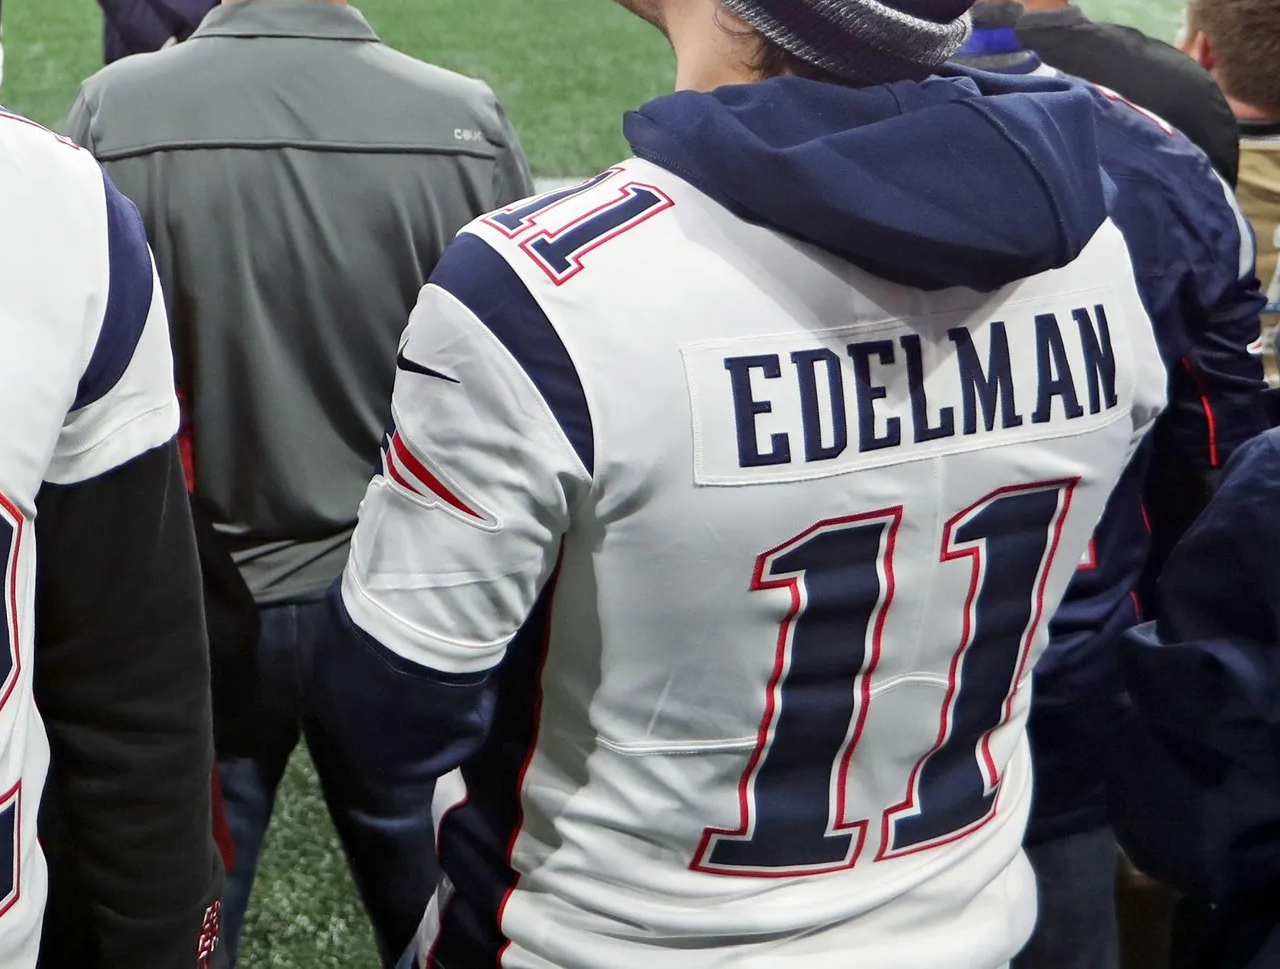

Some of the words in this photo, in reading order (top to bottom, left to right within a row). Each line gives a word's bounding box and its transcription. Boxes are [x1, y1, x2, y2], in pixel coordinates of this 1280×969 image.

[479, 167, 676, 287] 11
[722, 304, 1118, 468] EDELMAN
[687, 475, 1081, 878] 11
